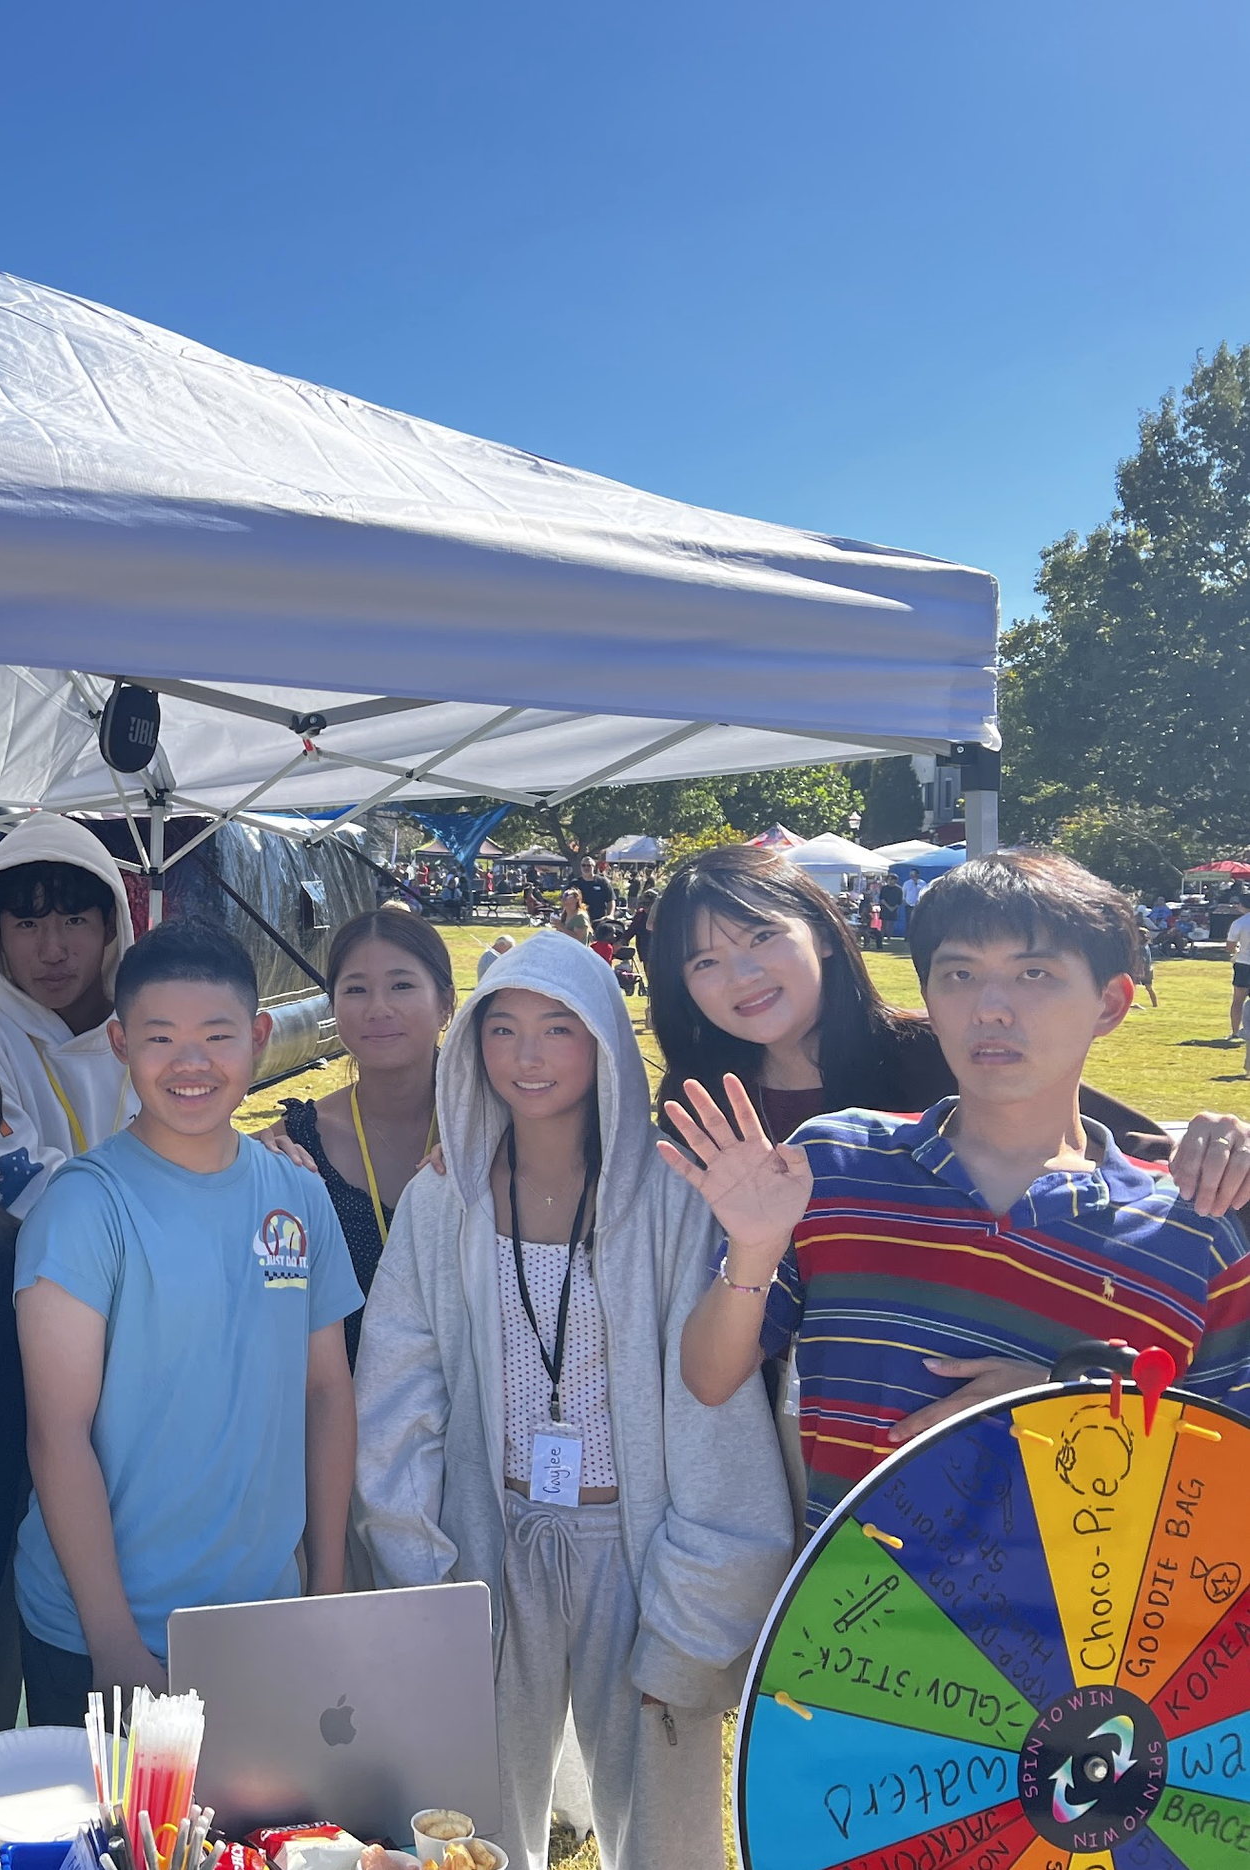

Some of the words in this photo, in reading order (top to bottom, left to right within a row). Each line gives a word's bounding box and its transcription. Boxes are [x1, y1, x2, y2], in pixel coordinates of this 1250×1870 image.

[129, 717, 156, 748] JBL
[266, 1255, 285, 1267] JUST
[286, 1255, 298, 1268] DO
[1125, 1557, 1179, 1678] GOODIE
[1165, 1478, 1206, 1538] BAG
[1164, 1609, 1250, 1721] KOREA
[1023, 1738, 1044, 1798] SPIN
[1038, 1707, 1063, 1732] TO
[1067, 1691, 1114, 1711] WIN
[1143, 1741, 1164, 1800] SPIN
[1074, 1827, 1120, 1848] WIN
[1124, 1806, 1149, 1831] TO
